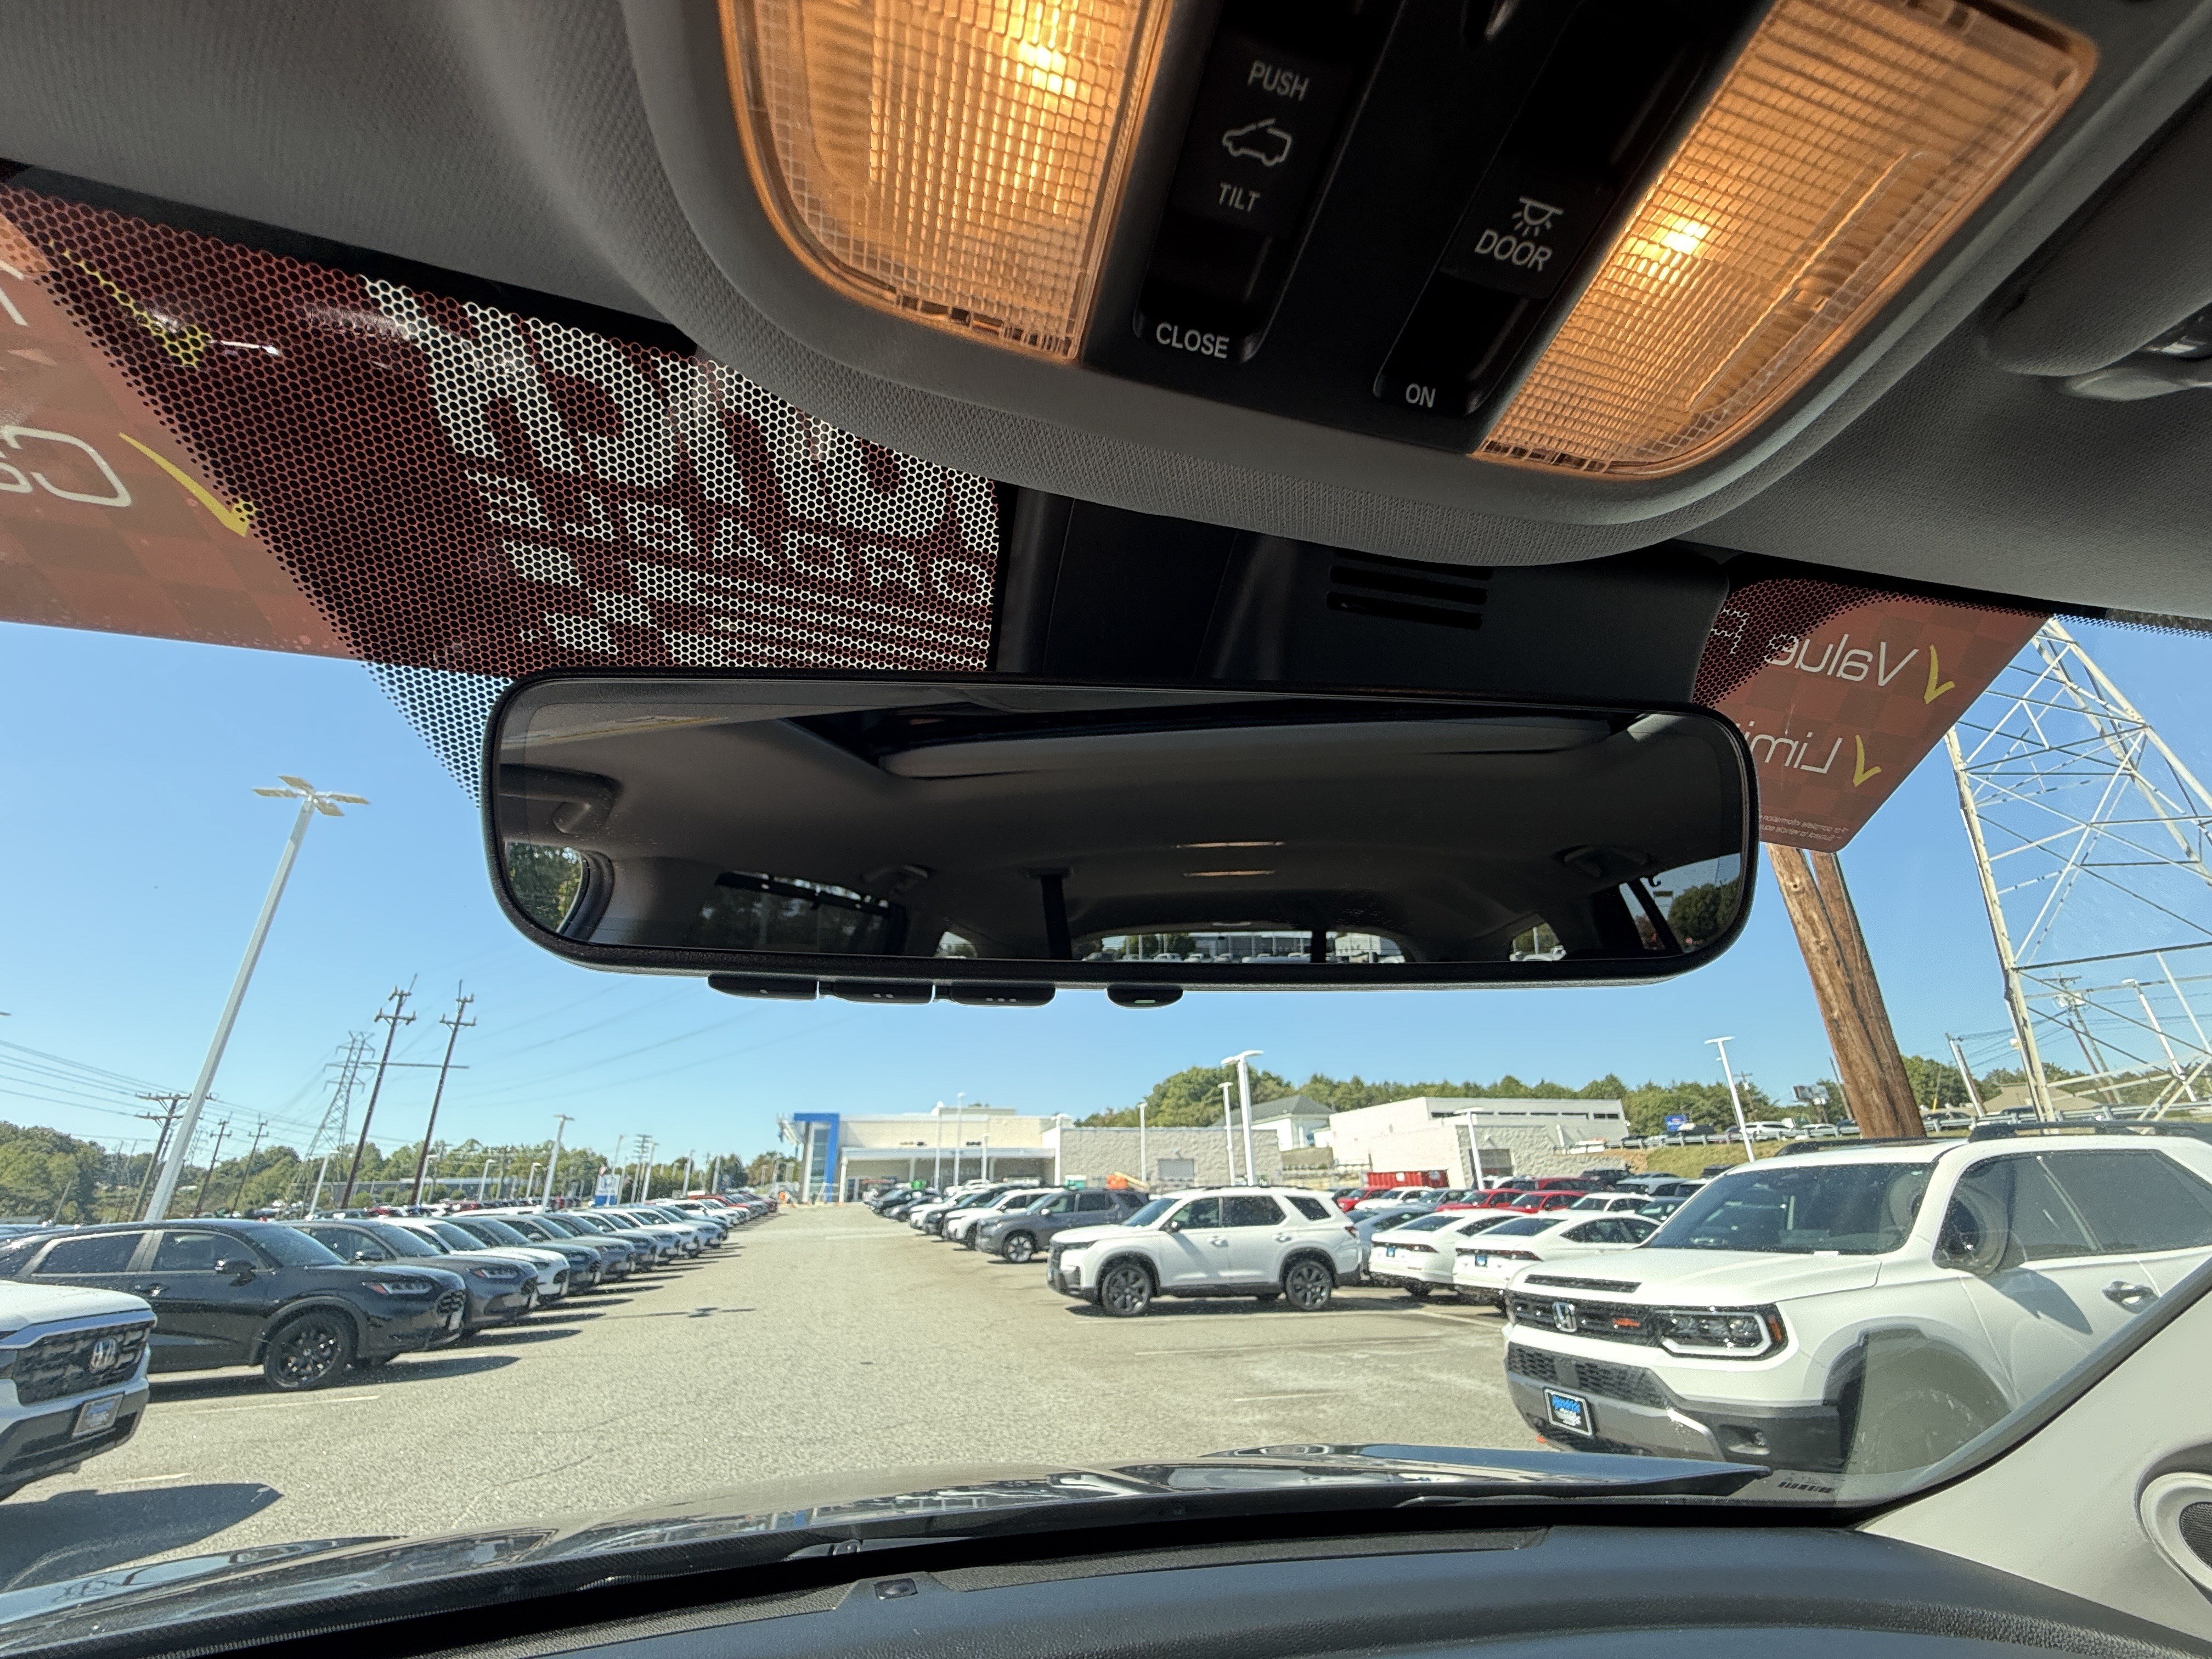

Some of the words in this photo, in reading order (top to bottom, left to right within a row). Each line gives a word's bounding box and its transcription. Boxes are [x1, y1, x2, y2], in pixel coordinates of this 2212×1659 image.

[1247, 60, 1310, 102] PUSH
[1218, 182, 1261, 213] TILT
[1474, 228, 1552, 273] DOOR
[1155, 322, 1230, 360] CLOSE
[1404, 382, 1436, 409] ON
